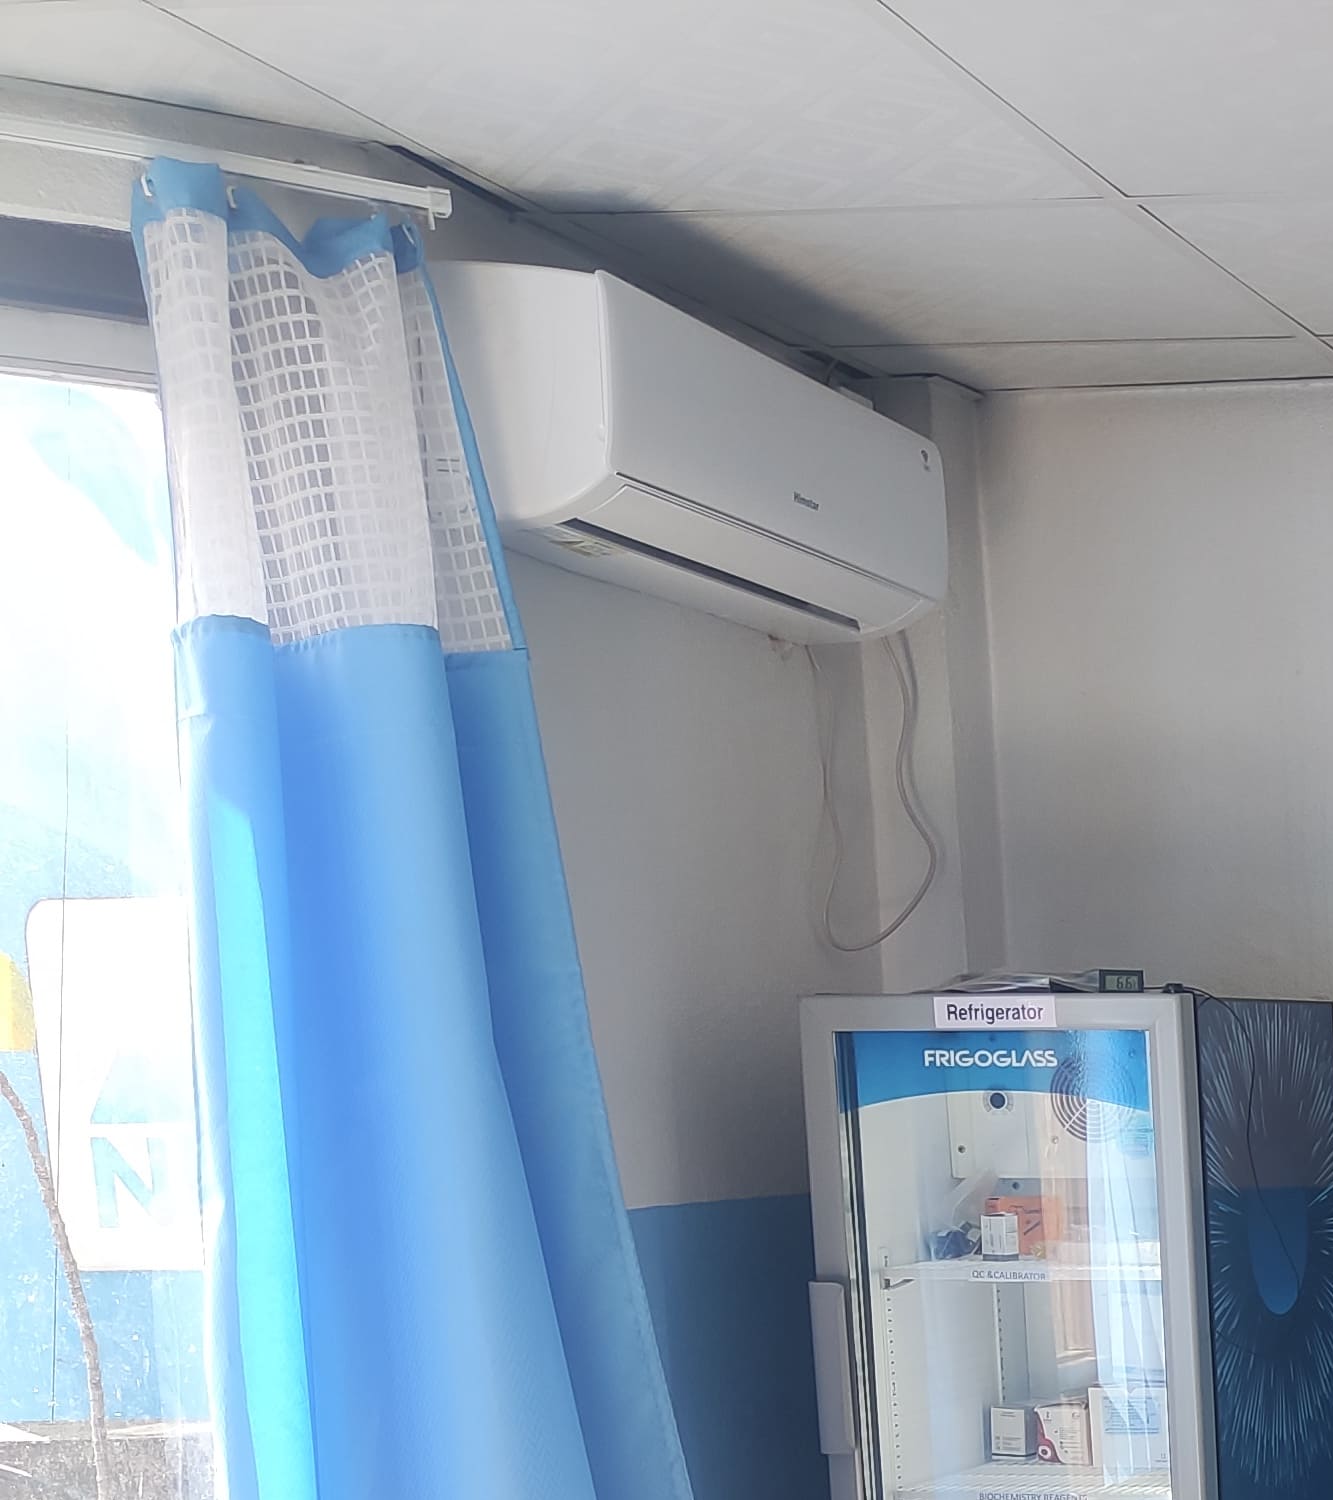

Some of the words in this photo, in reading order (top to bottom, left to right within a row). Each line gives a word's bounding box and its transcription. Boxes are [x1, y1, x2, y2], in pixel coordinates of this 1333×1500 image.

[946, 1003, 1044, 1025] Refrigerator
[924, 1049, 1058, 1068] FRIGOGLASS
[971, 1270, 985, 1279] QC
